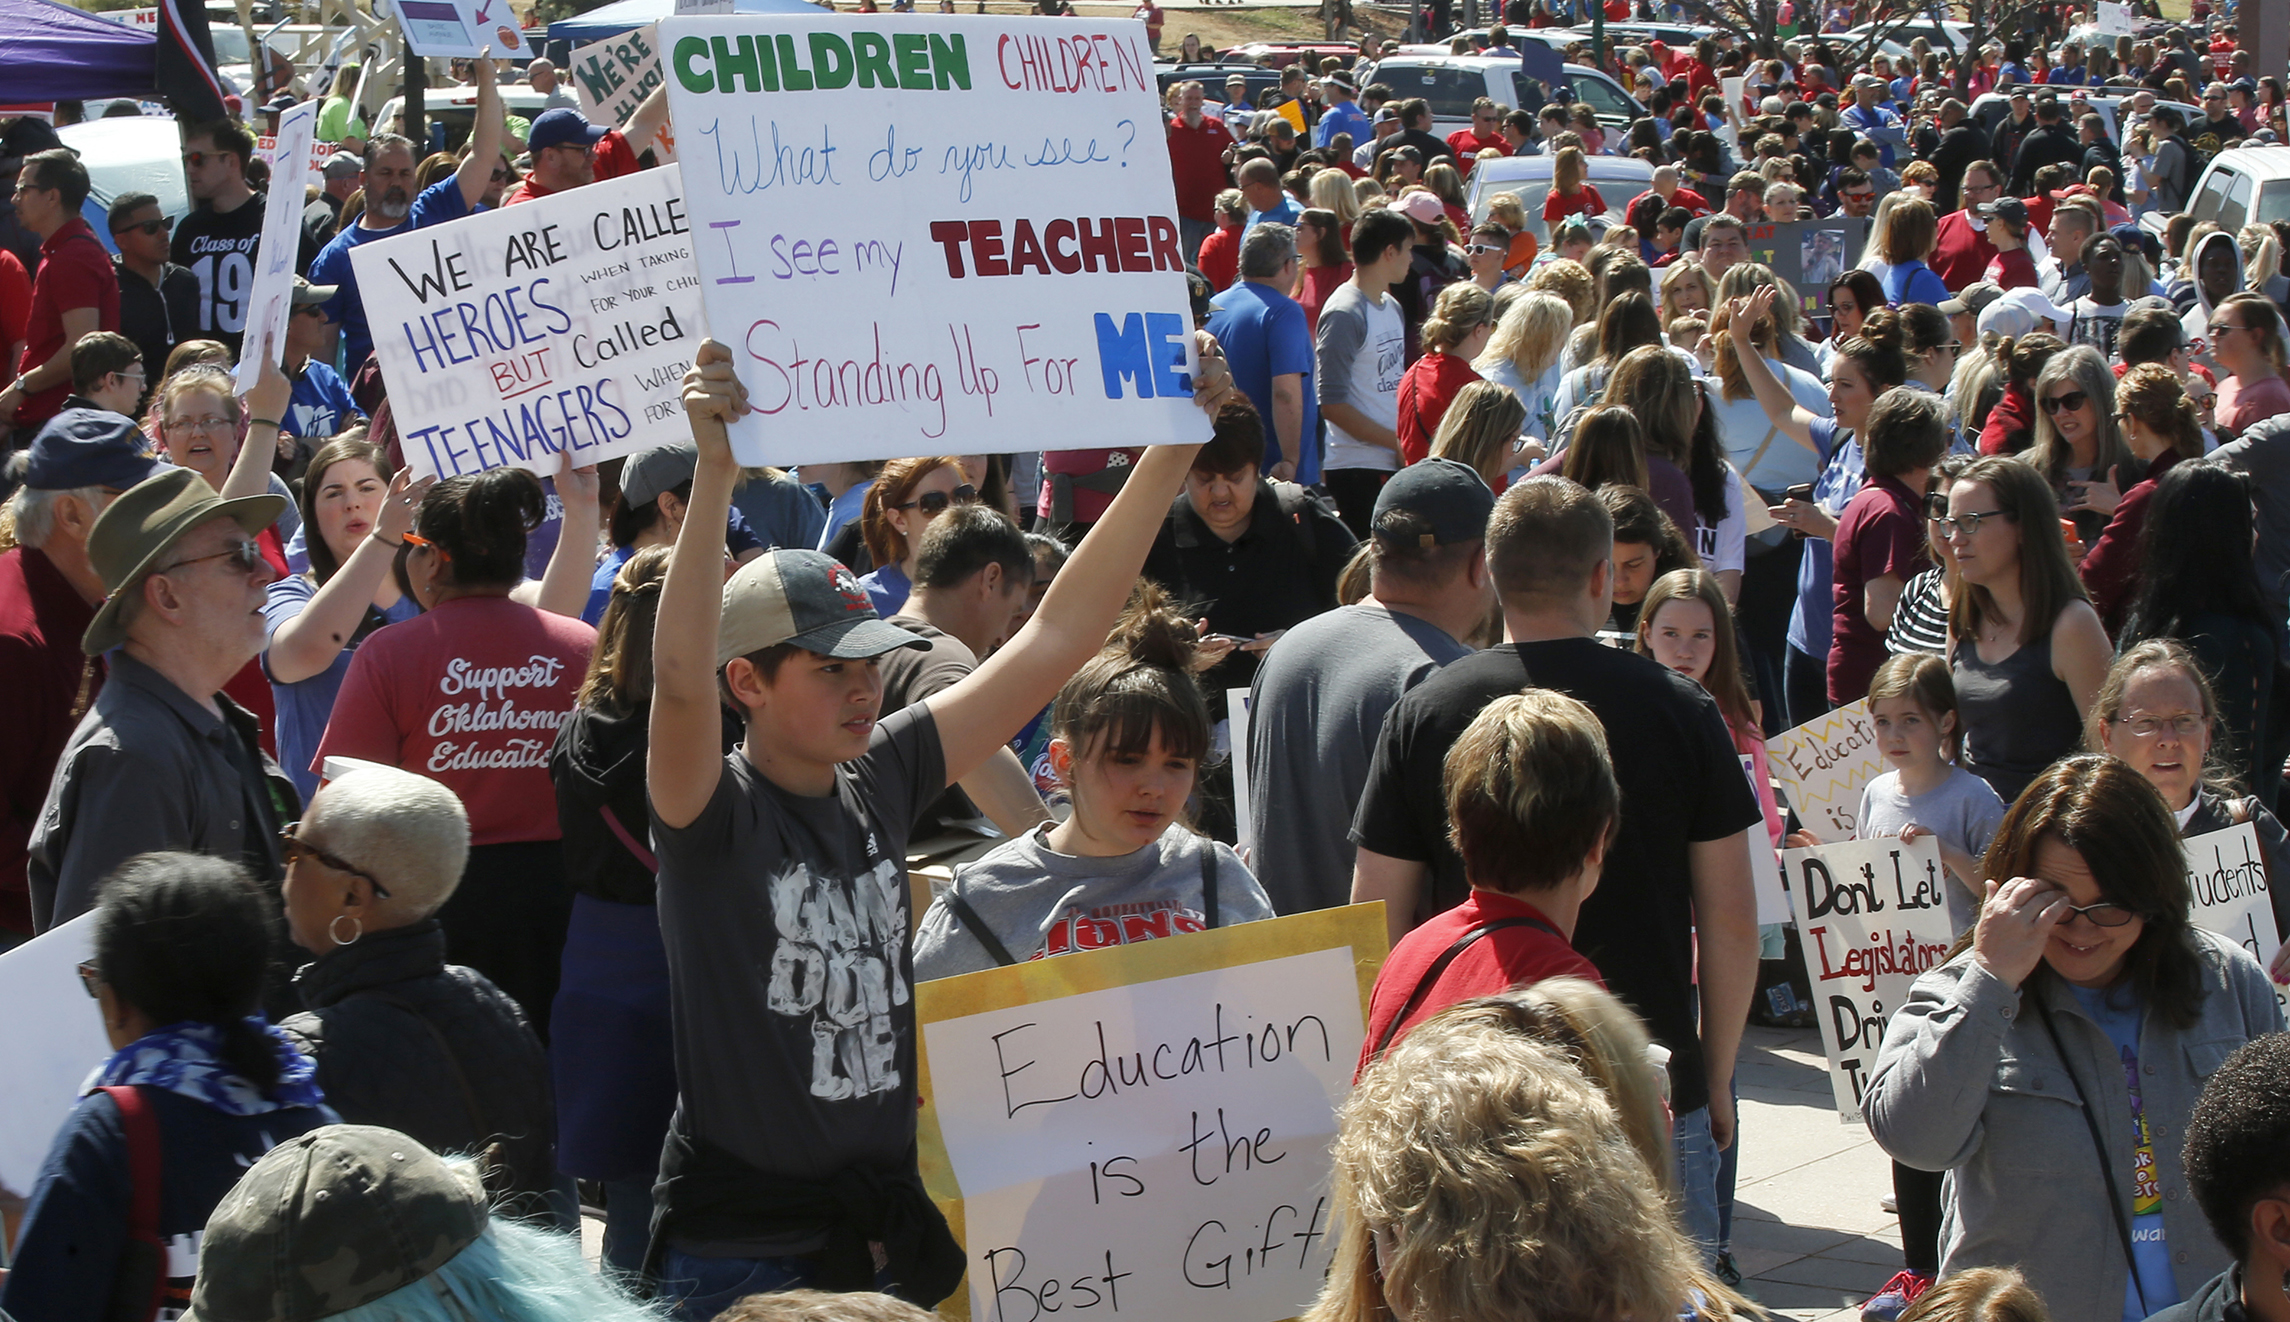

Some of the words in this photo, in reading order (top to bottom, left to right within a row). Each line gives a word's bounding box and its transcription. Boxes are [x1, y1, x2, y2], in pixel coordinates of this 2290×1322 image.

[575, 31, 652, 107] WE'RE
[672, 32, 972, 94] CHILDREN
[997, 33, 1146, 94] CHILDREN
[699, 115, 842, 195] What
[868, 123, 923, 181] do
[938, 142, 1017, 203] you
[190, 234, 236, 254] Class
[237, 233, 260, 255] of
[388, 239, 474, 304] WE
[504, 224, 568, 278] ARE
[592, 197, 690, 251] CALLE
[580, 261, 630, 285] WHEN
[636, 247, 690, 270] TAKING
[709, 219, 756, 285] I
[770, 233, 840, 280] see
[853, 239, 903, 297] my
[929, 216, 1185, 279] TEACHER
[191, 252, 255, 333] 19
[402, 277, 572, 374] HEROES
[590, 296, 620, 314] FOR
[623, 285, 656, 303] YOUR
[666, 275, 700, 293] CHIL
[489, 347, 552, 394] BUT
[573, 305, 685, 369] Called
[746, 319, 946, 438] Standing
[948, 322, 999, 417] Up
[1016, 322, 1079, 396] For
[1093, 312, 1195, 399] ME
[406, 378, 633, 482] TEENAGERS
[643, 400, 677, 424] FOR
[439, 654, 566, 701] Support
[1786, 718, 1876, 782] Educati
[1826, 805, 1856, 832] is
[1801, 857, 1885, 920] Don't
[1889, 850, 1943, 911] Let
[2188, 835, 2267, 909] tudents
[1030, 908, 1206, 960] IONS
[1809, 925, 1949, 993] Legislators
[991, 1003, 1331, 1119] Education
[1088, 1141, 1145, 1204] is
[1178, 1107, 1287, 1186] the
[984, 1246, 1134, 1322] Best
